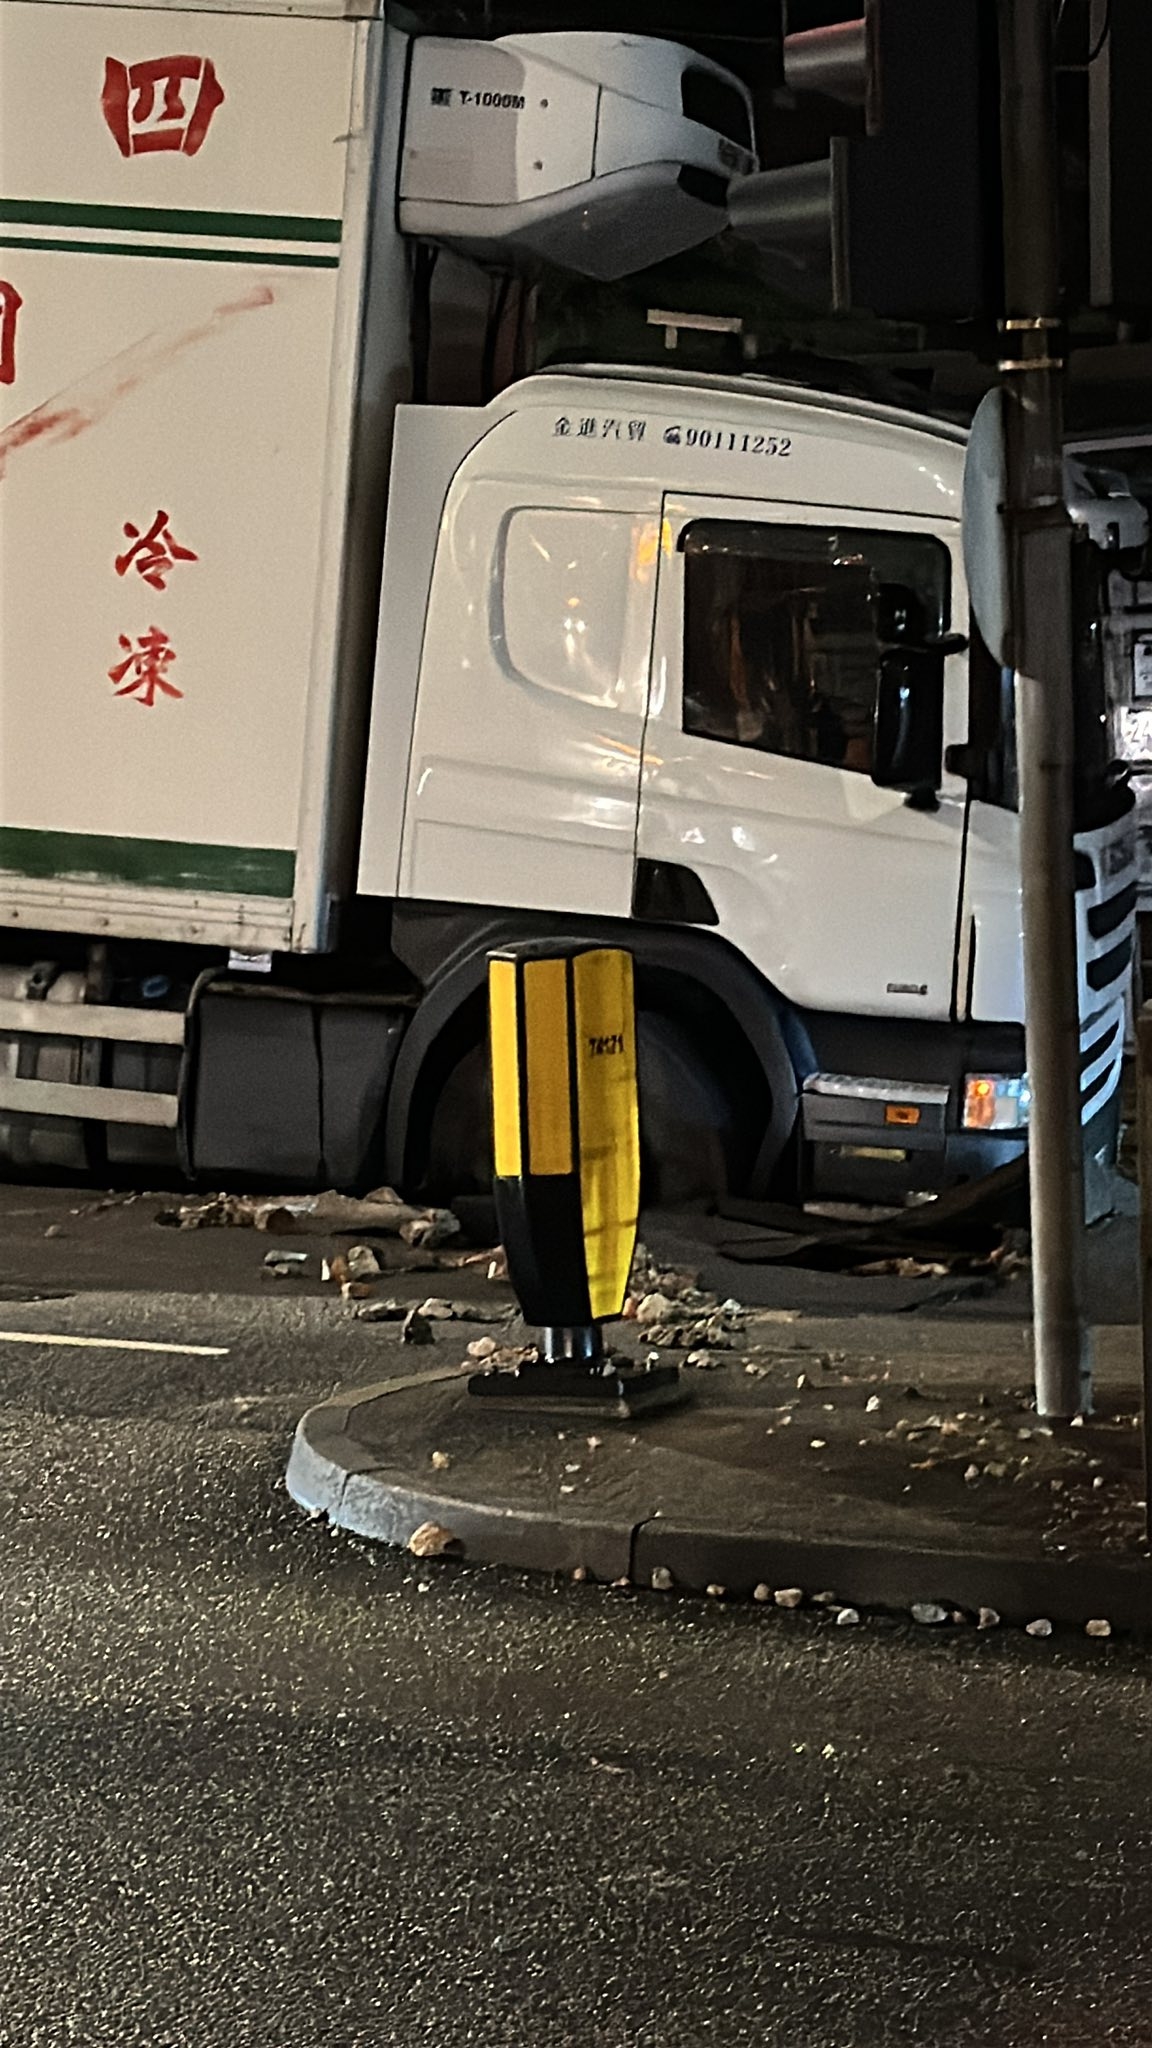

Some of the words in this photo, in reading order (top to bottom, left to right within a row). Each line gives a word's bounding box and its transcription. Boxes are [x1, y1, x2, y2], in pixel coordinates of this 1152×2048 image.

[101, 54, 225, 158] 四
[460, 90, 525, 109] T-1000M
[686, 428, 792, 457] 90111252
